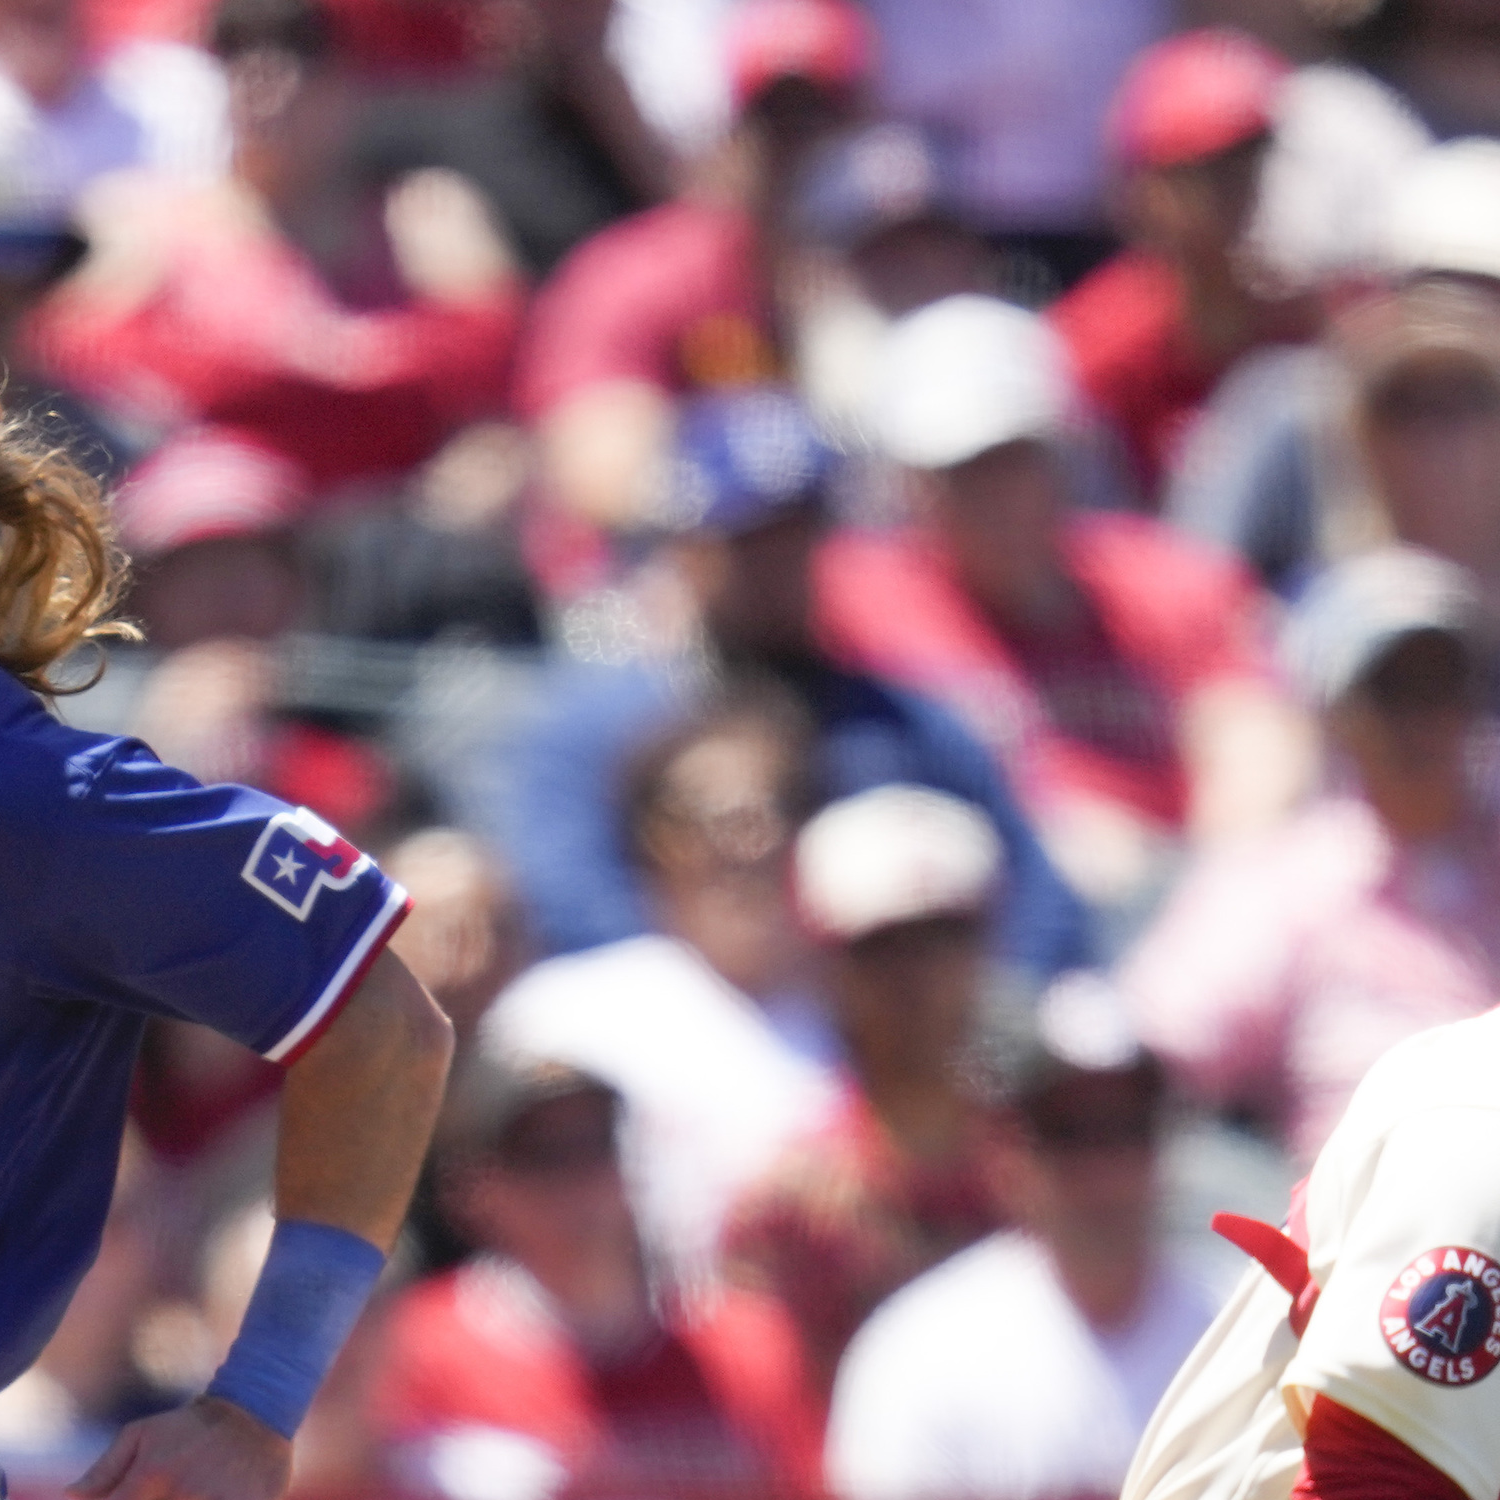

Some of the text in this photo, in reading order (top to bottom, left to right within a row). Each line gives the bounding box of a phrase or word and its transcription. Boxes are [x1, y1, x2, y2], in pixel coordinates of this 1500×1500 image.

[1388, 1257, 1437, 1301] LOS
[1382, 1316, 1476, 1383] ANGELS
[1413, 1278, 1479, 1354] A
